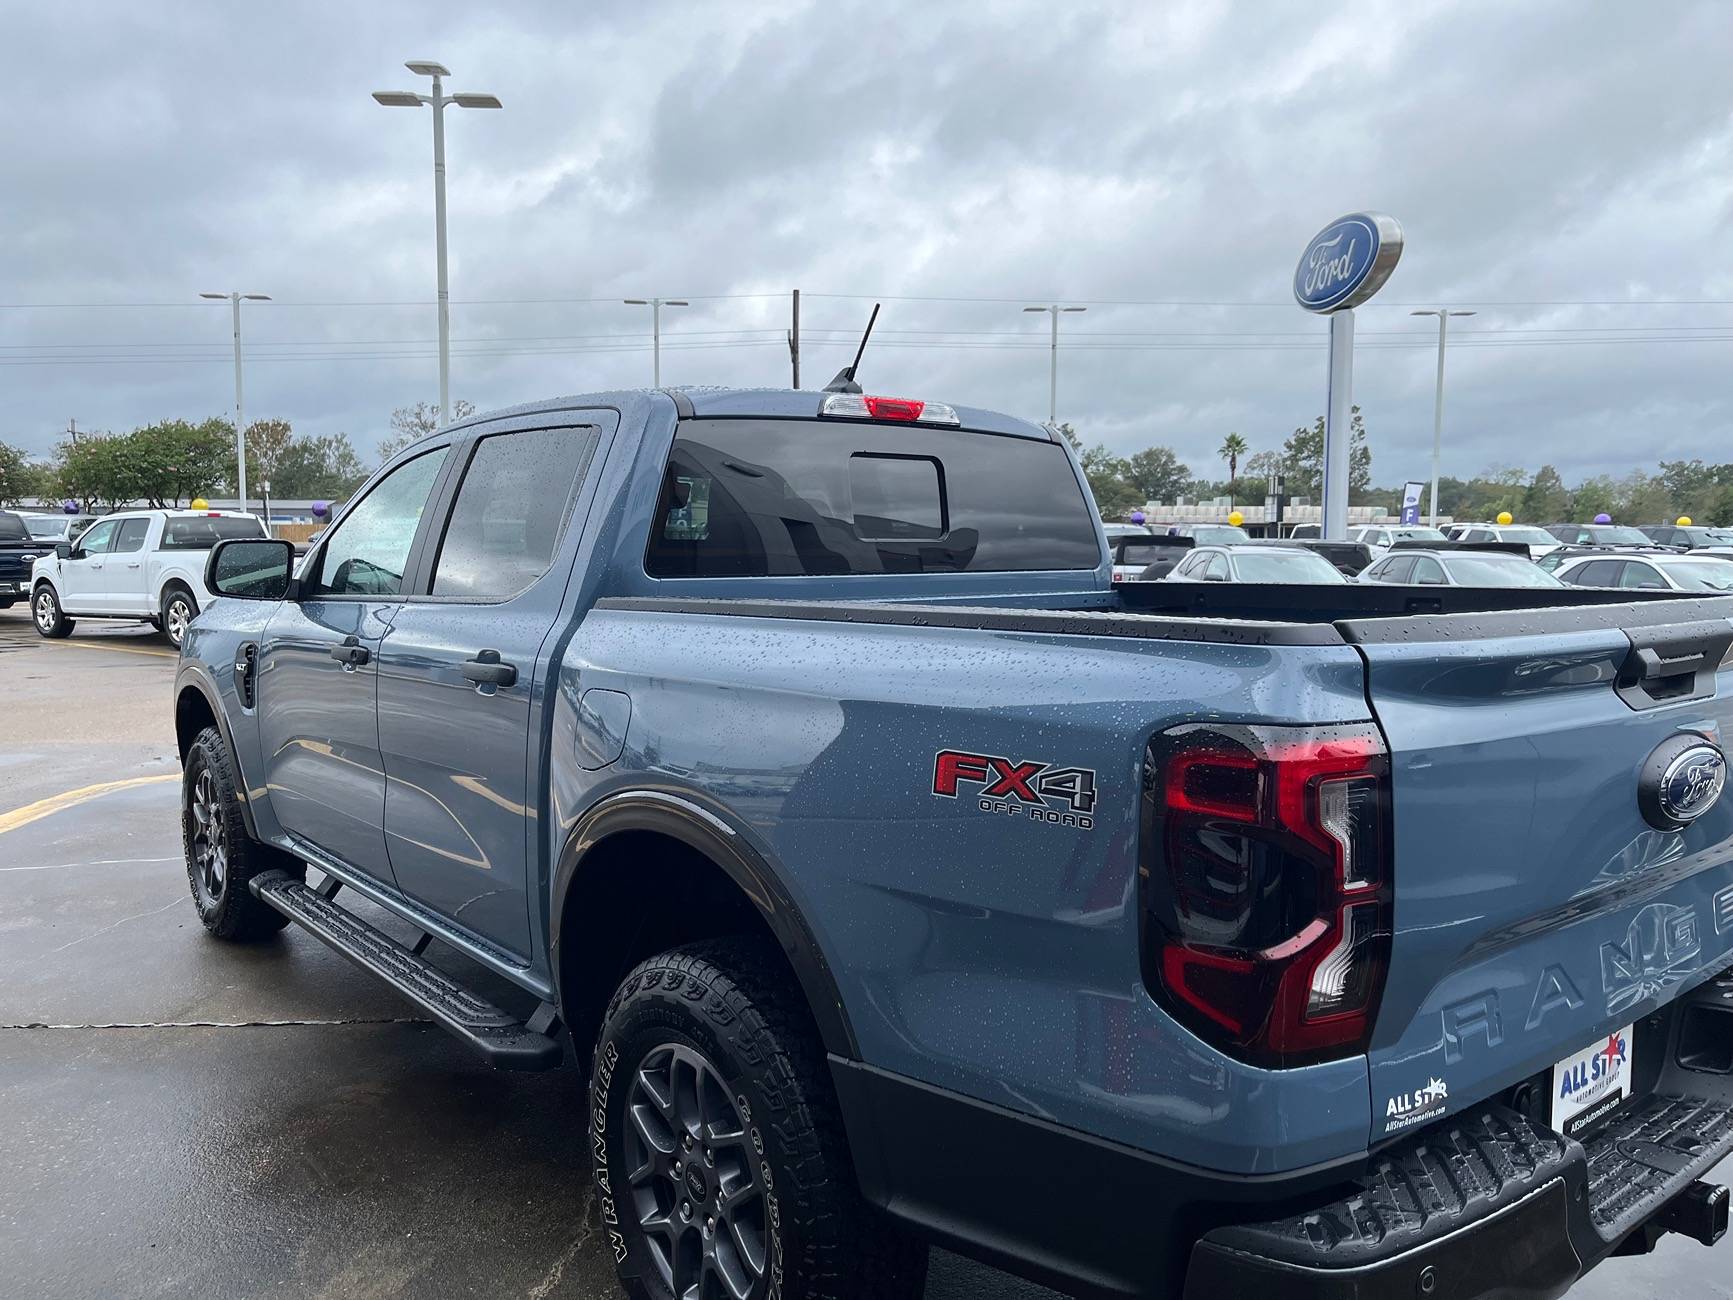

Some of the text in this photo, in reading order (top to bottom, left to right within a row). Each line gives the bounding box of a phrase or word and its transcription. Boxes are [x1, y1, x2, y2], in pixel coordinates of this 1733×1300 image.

[1304, 233, 1356, 296] Ford
[932, 749, 1097, 814] FX4
[1682, 757, 1721, 807] Ford
[978, 799, 1095, 831] OFF ROAD
[1560, 1061, 1588, 1099] ALL
[1576, 1081, 1605, 1103] AUTOMOTIVE
[1385, 1106, 1446, 1133] AllStarAutomotive.com
[1386, 1094, 1412, 1117] ALL
[1570, 1098, 1620, 1134] AllStarAutomotive.com
[592, 1040, 628, 1264] WRANGLER
